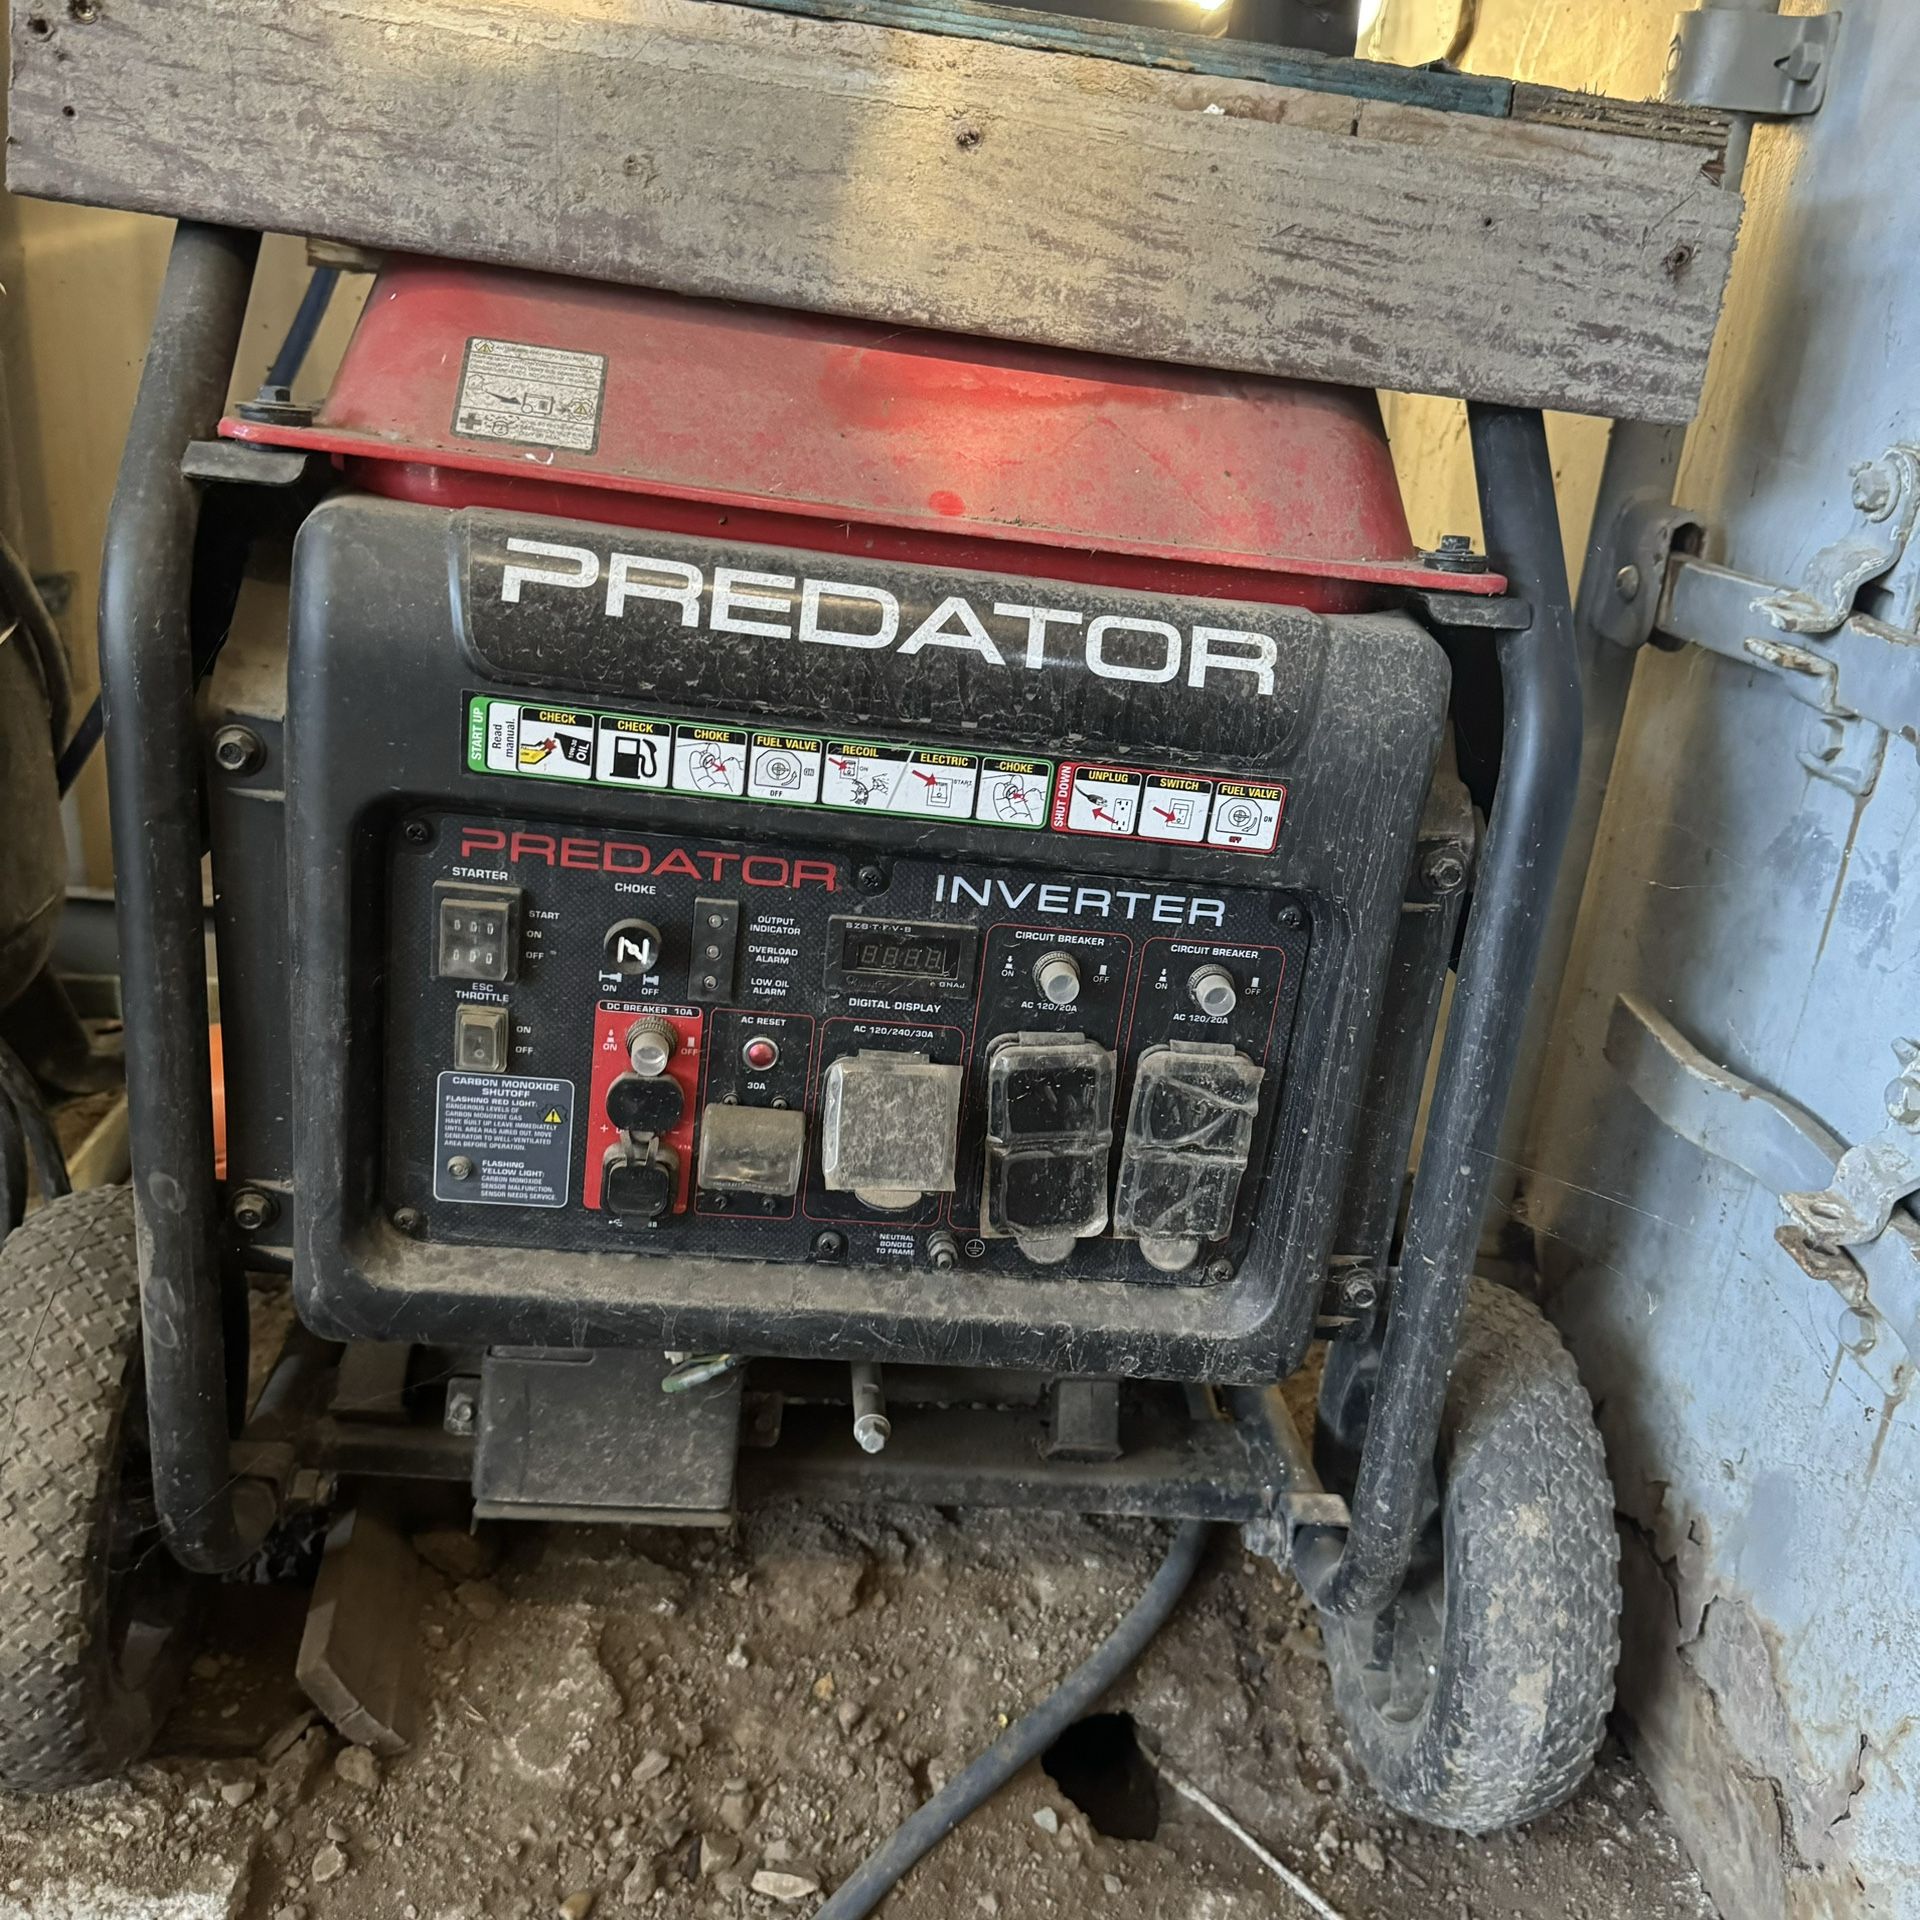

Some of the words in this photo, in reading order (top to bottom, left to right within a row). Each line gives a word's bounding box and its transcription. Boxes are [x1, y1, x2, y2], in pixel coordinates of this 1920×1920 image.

[500, 537, 1278, 696] PREDATOR
[475, 707, 484, 722] UP
[539, 711, 576, 725] CHECK
[617, 720, 653, 734] CHECK
[492, 724, 502, 750] Read
[505, 718, 516, 758] manual.
[694, 728, 730, 742] CHOKE
[472, 724, 483, 761] START
[757, 736, 784, 749] FUEL
[786, 738, 817, 751] VALVE
[576, 743, 590, 761] OIL
[843, 745, 879, 758] RECOIL
[920, 753, 969, 767] ELECTRIC
[1000, 761, 1033, 774] CHOKE
[1088, 771, 1129, 783] UNPLUG
[1160, 777, 1199, 791] SWITCH
[770, 790, 782, 798] OFF
[1054, 802, 1066, 827] SHUT
[1060, 765, 1071, 798] DOWN
[1222, 785, 1246, 796] FUEL
[1249, 787, 1279, 800] VALVE
[461, 827, 838, 891] PREDATOR
[452, 866, 509, 881] STARTER
[614, 882, 657, 895] CHOKE
[935, 874, 1225, 927] INVERTER
[529, 910, 560, 920] START
[758, 916, 794, 926] OUTPUT
[526, 930, 542, 938] ON
[750, 924, 800, 936] INDICATOR
[1015, 931, 1055, 942] CIRCUIT
[1058, 934, 1105, 946] BREAKER
[748, 945, 798, 956] OVERLOAD
[1170, 944, 1210, 954] CIRCUIT
[1212, 948, 1258, 959] BREAKER
[526, 952, 544, 960] OFF
[756, 955, 790, 964] ALARM
[472, 982, 494, 992] ESC
[602, 984, 616, 992] ON
[751, 978, 772, 987] LOW
[774, 979, 790, 988] OIL
[1154, 982, 1168, 990] ON
[455, 990, 510, 1003] THROTTLE
[641, 988, 660, 996] OFF
[752, 987, 786, 996] ALARM
[1244, 988, 1262, 996] OFF
[607, 1002, 620, 1011] DC
[623, 1004, 668, 1014] BREAKER
[674, 1007, 693, 1016] 10A
[848, 997, 891, 1010] DIGITAL
[894, 1001, 942, 1014] DISPLAY
[1020, 1001, 1034, 1009] AC
[1036, 1002, 1078, 1012] 120/20A
[741, 1016, 754, 1025] AC
[756, 1017, 786, 1026] RESET
[1173, 1013, 1186, 1021] AC
[1188, 1014, 1229, 1024] 120/20A
[516, 1026, 532, 1034] ON
[854, 1025, 866, 1034] AC
[869, 1025, 934, 1039] 120/240/30A
[515, 1046, 534, 1054] OFF
[602, 1043, 618, 1052] ON
[680, 1048, 698, 1056] OFF
[452, 1076, 498, 1087] CARBON
[501, 1079, 560, 1092] MONOXIDE
[747, 1082, 766, 1090] 30A
[482, 1088, 530, 1098] SHUTOFF
[446, 1095, 489, 1104] FLASHING
[492, 1098, 510, 1106] RED
[446, 1103, 485, 1112] DANGEROUS
[446, 1110, 472, 1118] CARBON
[474, 1112, 508, 1120] MONOXIDE
[514, 1122, 558, 1131] IMMEDIATELY
[444, 1132, 482, 1140] GENERATOR
[484, 1134, 492, 1142] TO
[498, 1128, 518, 1136] AIRED
[482, 1160, 525, 1168] FLASHING
[482, 1168, 517, 1176] YELLOW
[508, 1176, 542, 1185] MONOXIDE
[480, 1182, 506, 1190] SENSOR
[480, 1190, 506, 1198] SENSOR
[880, 1234, 915, 1242] NEUTRAL
[880, 1240, 914, 1248] BONDED
[887, 1248, 915, 1256] FRAME
